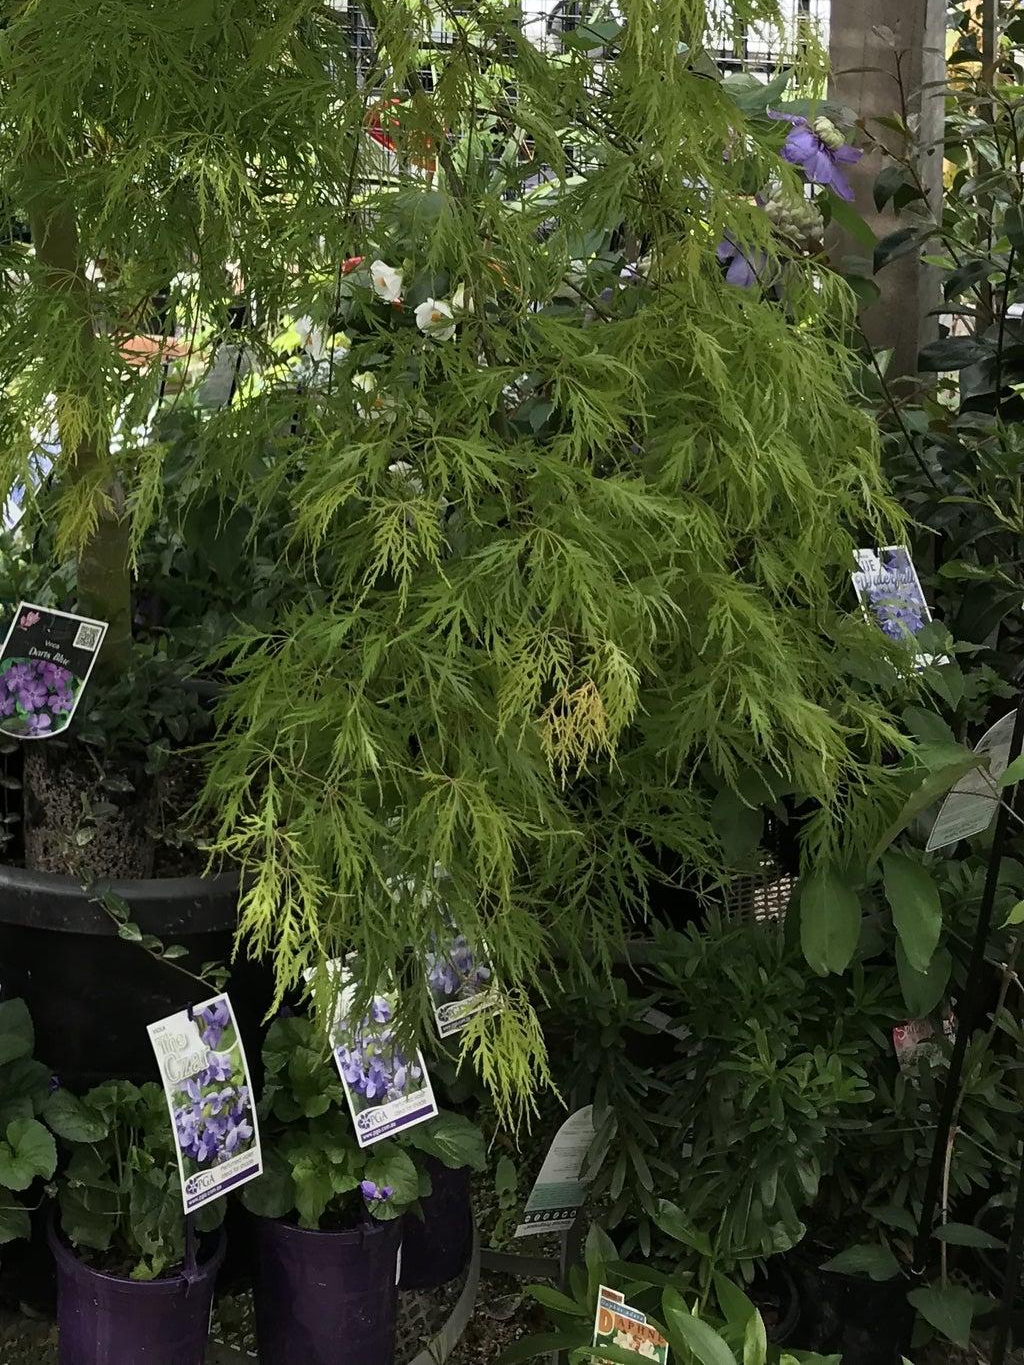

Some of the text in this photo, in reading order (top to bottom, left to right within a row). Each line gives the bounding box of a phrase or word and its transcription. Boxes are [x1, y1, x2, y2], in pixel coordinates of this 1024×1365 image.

[45, 639, 61, 650] Vinca
[154, 1032, 187, 1054] The
[163, 1046, 210, 1083] Czar
[370, 1111, 388, 1126] PGA
[197, 1174, 215, 1191] PGA
